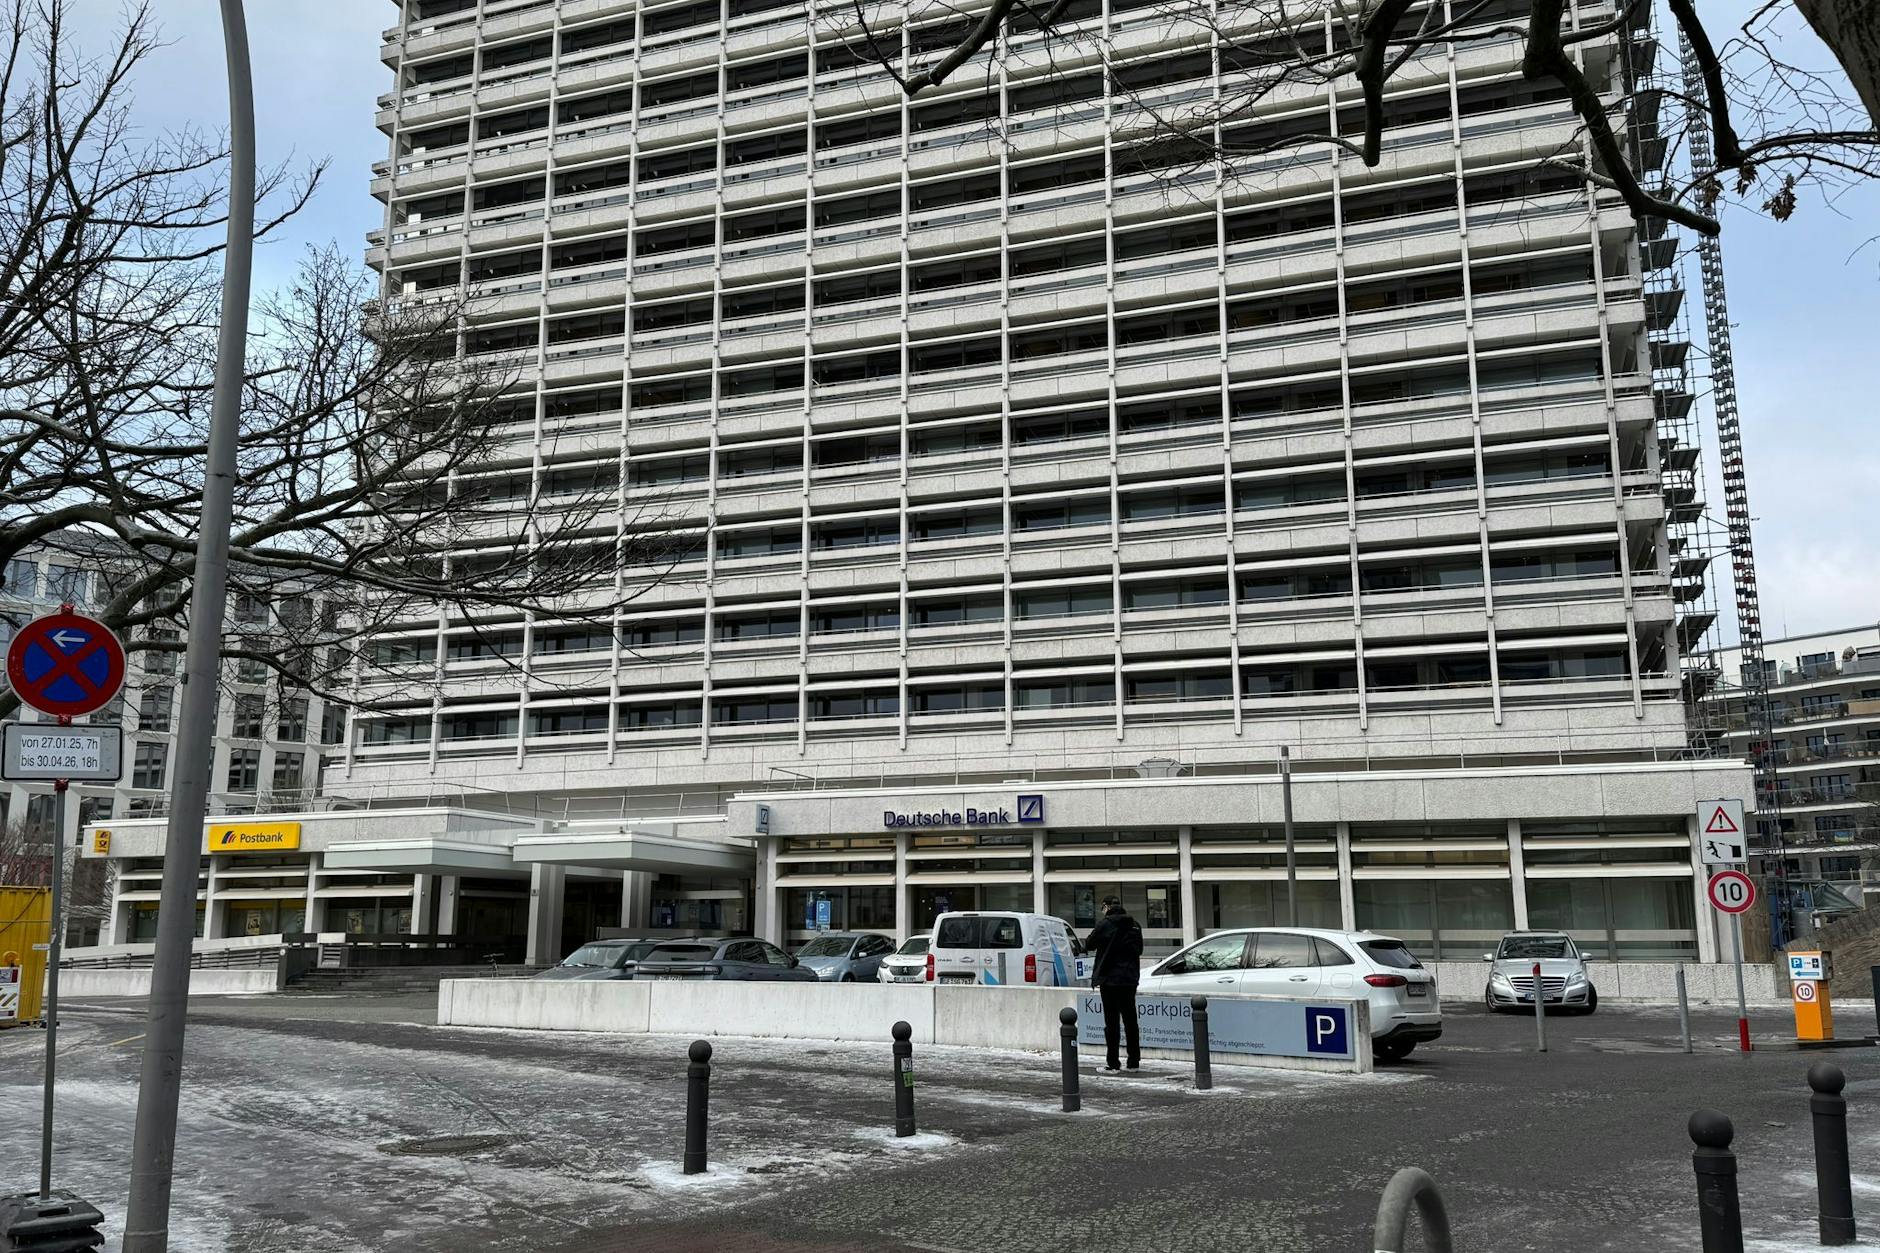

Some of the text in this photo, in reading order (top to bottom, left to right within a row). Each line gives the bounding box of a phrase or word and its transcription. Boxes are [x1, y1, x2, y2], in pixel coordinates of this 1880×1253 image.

[21, 737, 98, 750] von 27.01.25, 7h
[21, 755, 98, 769] bis 30.04.26, 18h
[884, 807, 1009, 827] Deutsche Bank
[240, 831, 283, 844] Postbank
[1719, 882, 1743, 902] 10
[1793, 958, 1801, 968] P
[1800, 987, 1810, 997] 10
[1085, 998, 1190, 1021] Kuparkpla
[1316, 1015, 1336, 1045] P
